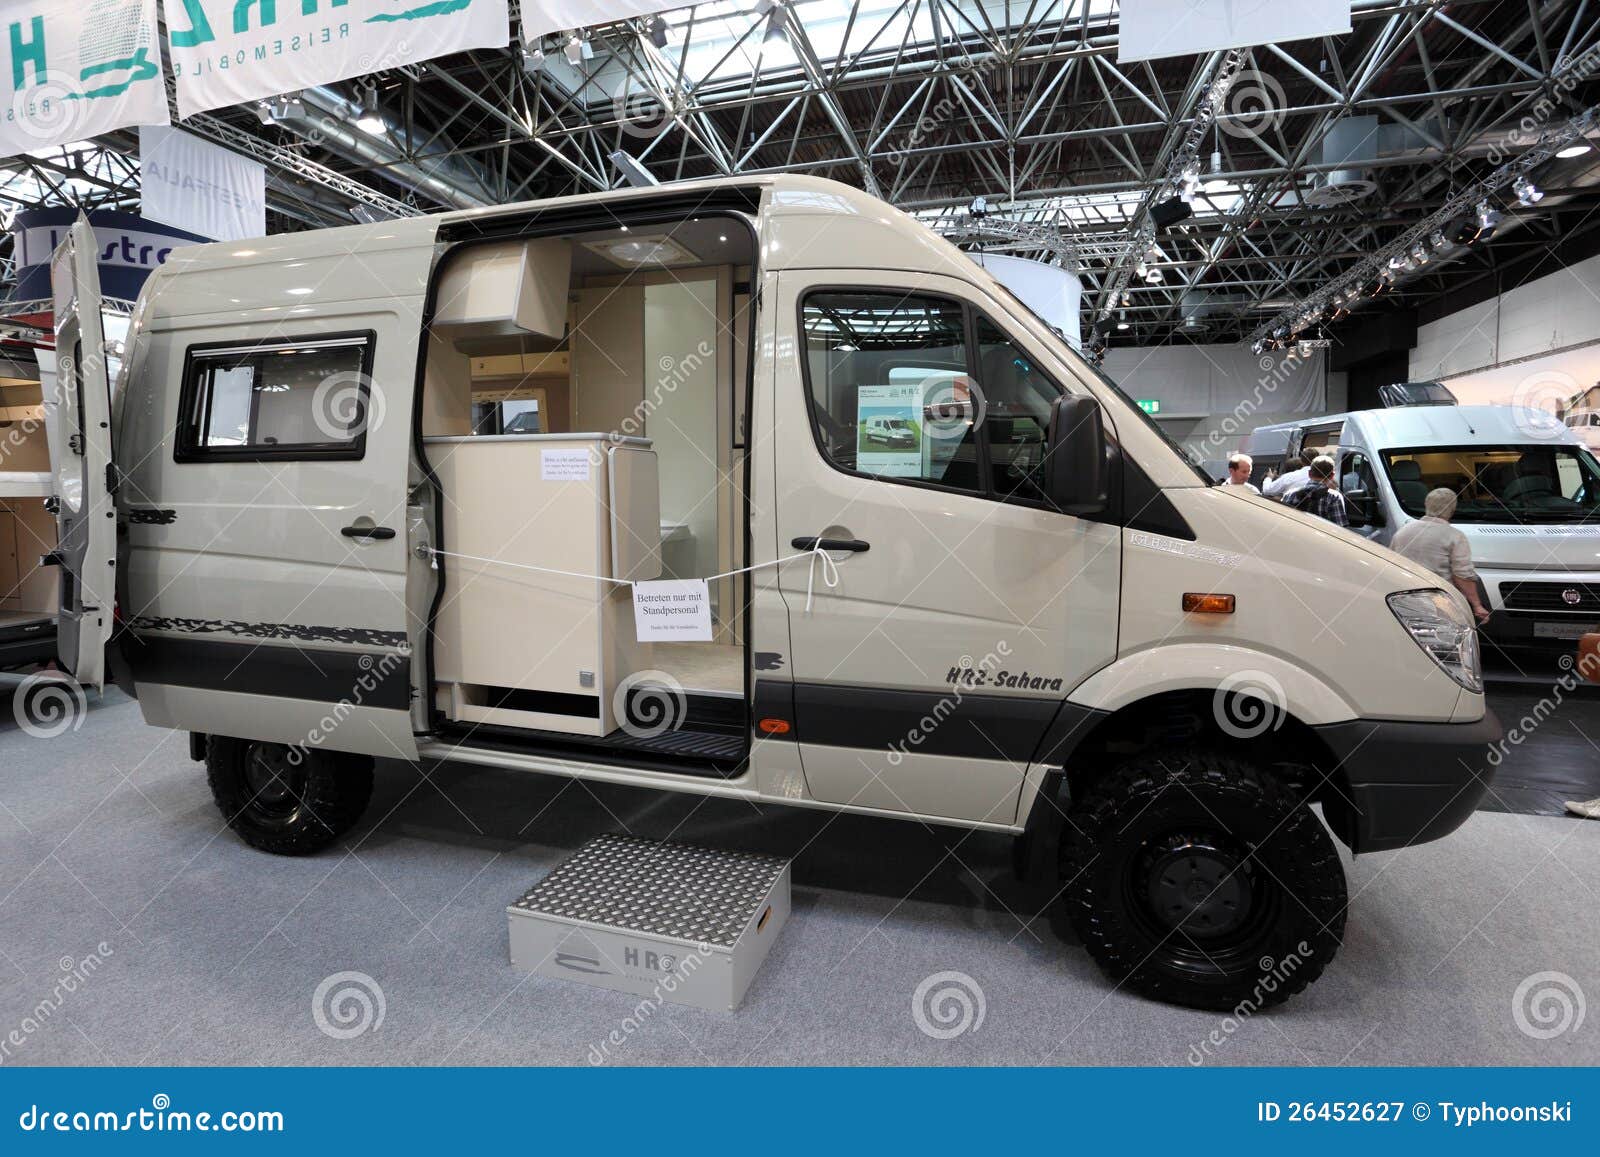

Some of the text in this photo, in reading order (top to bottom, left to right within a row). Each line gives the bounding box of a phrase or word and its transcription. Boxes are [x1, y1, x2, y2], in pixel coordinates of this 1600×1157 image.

[637, 594, 671, 602] Betreten
[688, 592, 702, 600] mit
[642, 605, 699, 616] Standpersonal
